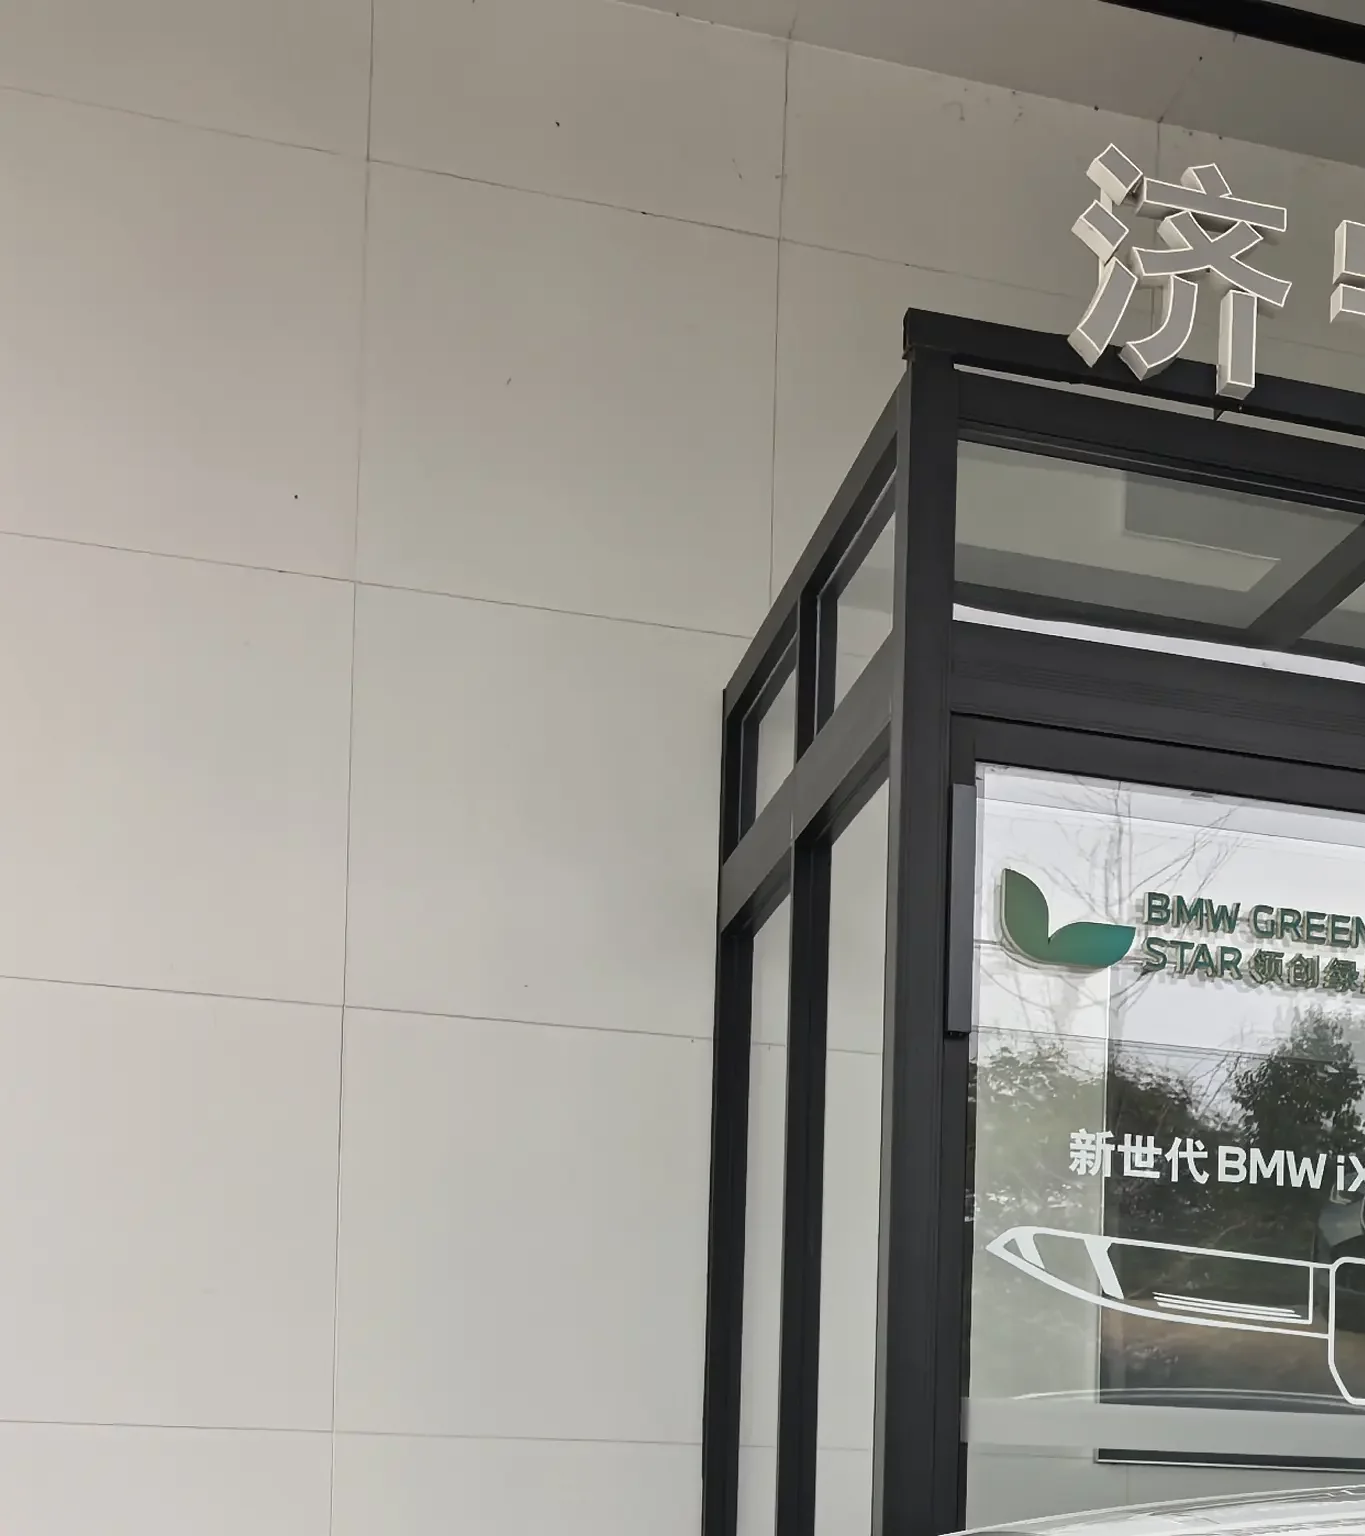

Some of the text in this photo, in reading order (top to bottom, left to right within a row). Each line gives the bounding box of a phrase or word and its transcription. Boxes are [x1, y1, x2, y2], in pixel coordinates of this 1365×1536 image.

[1143, 891, 1241, 934] BMW
[1142, 936, 1243, 980] STAR
[1069, 1128, 1209, 1185] 新世代
[1217, 1145, 1327, 1189] BMW
